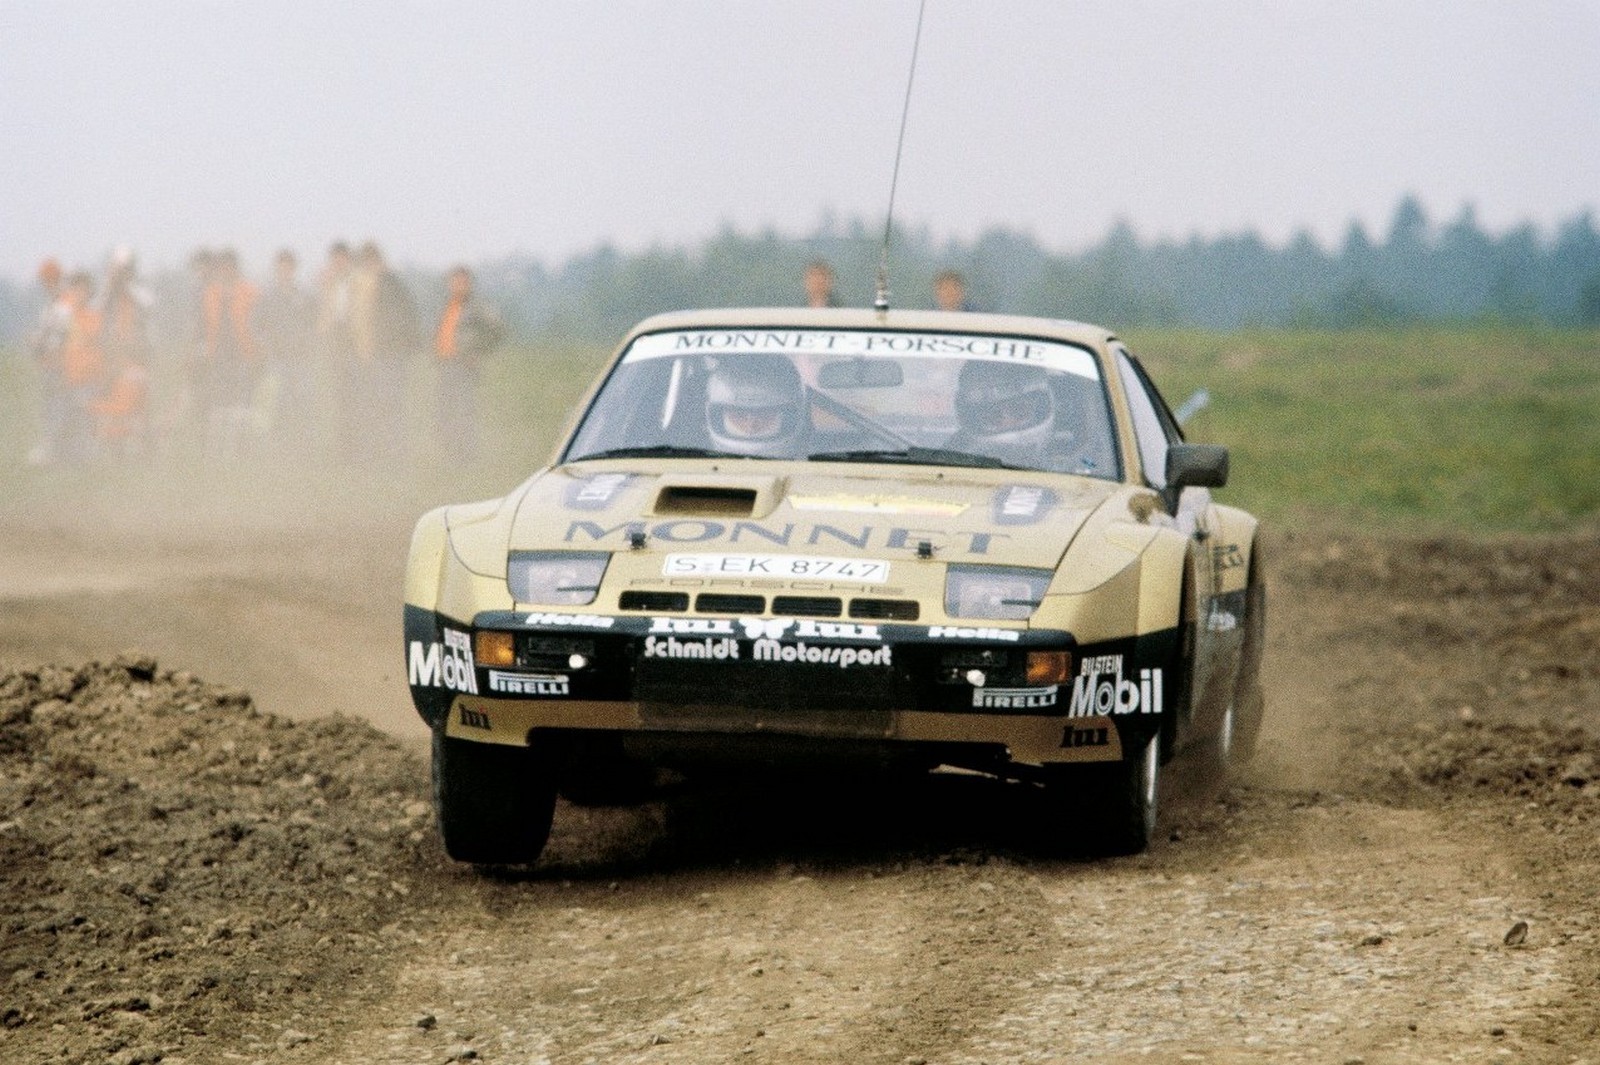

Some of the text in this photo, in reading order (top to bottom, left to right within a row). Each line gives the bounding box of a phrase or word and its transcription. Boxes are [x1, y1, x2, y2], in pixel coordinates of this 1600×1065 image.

[564, 520, 1011, 554] MONNET
[790, 560, 880, 577] 8747
[928, 626, 1020, 642] Hella
[644, 636, 893, 669] Schmidt Motorsport
[1080, 654, 1124, 676] BILSTEIN
[408, 640, 478, 695] Mobil
[488, 669, 569, 694] PIRELLI
[1068, 667, 1163, 719] Mobil
[972, 684, 1059, 708] PIRELLI
